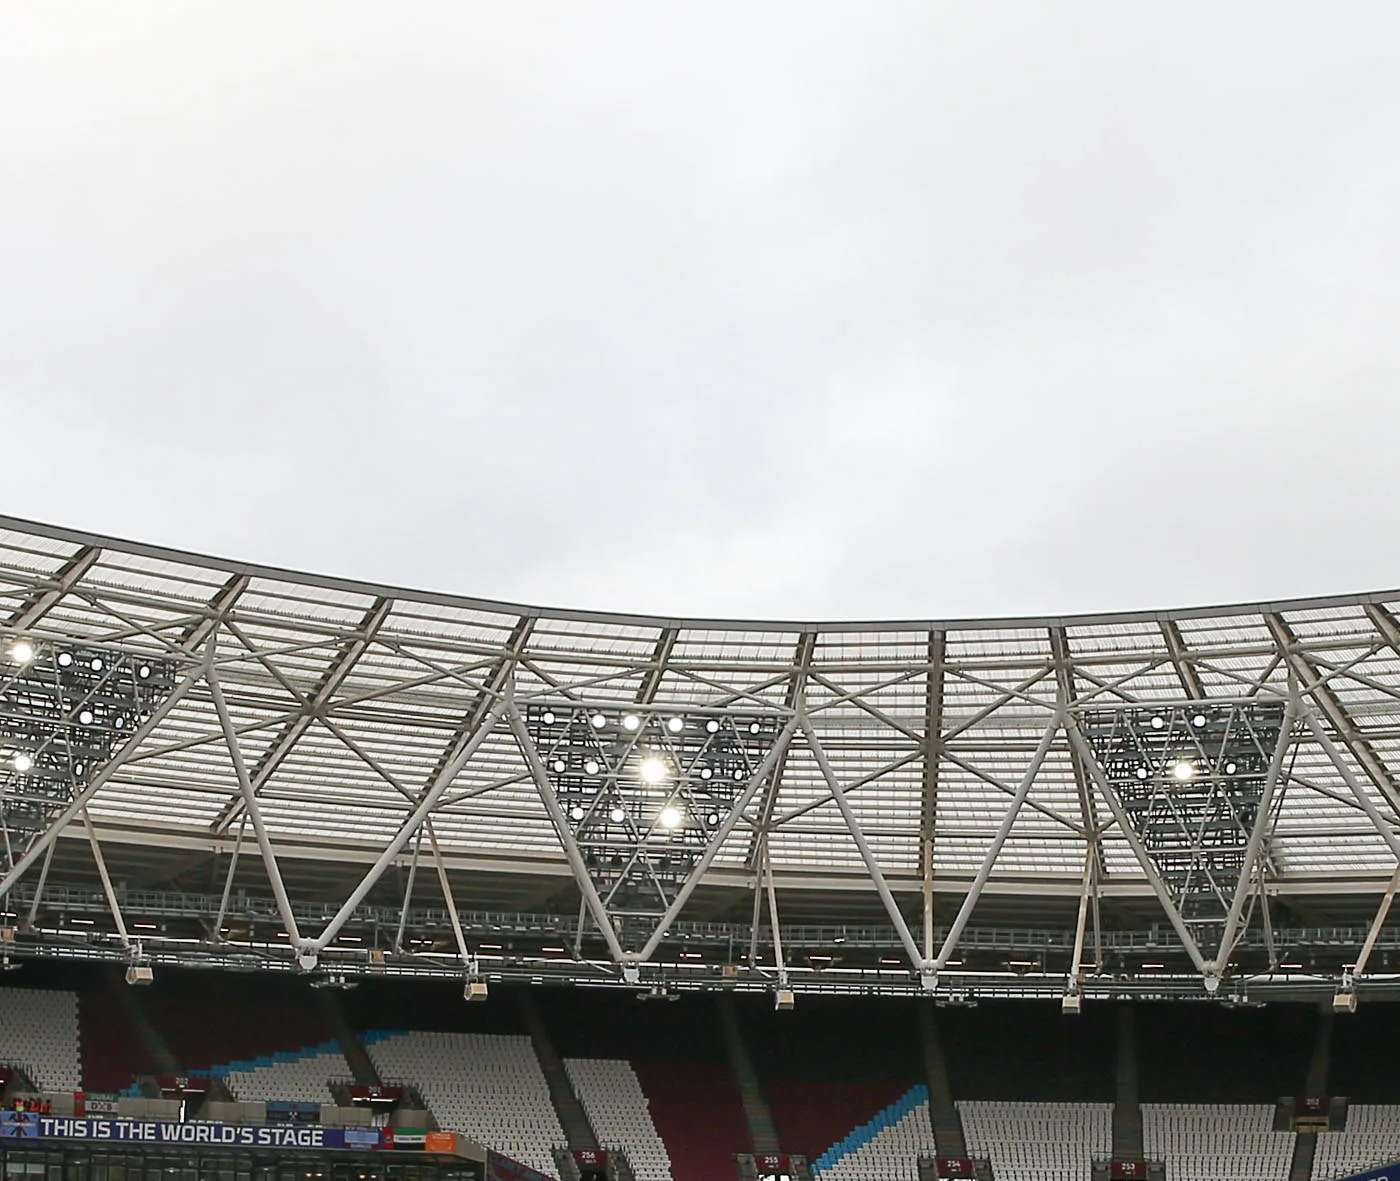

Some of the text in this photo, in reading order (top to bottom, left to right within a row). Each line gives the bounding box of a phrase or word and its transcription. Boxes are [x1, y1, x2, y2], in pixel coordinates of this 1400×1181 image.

[40, 1118, 324, 1147] THIS IS THE WORLD'S STAGE
[765, 1156, 778, 1164] 255
